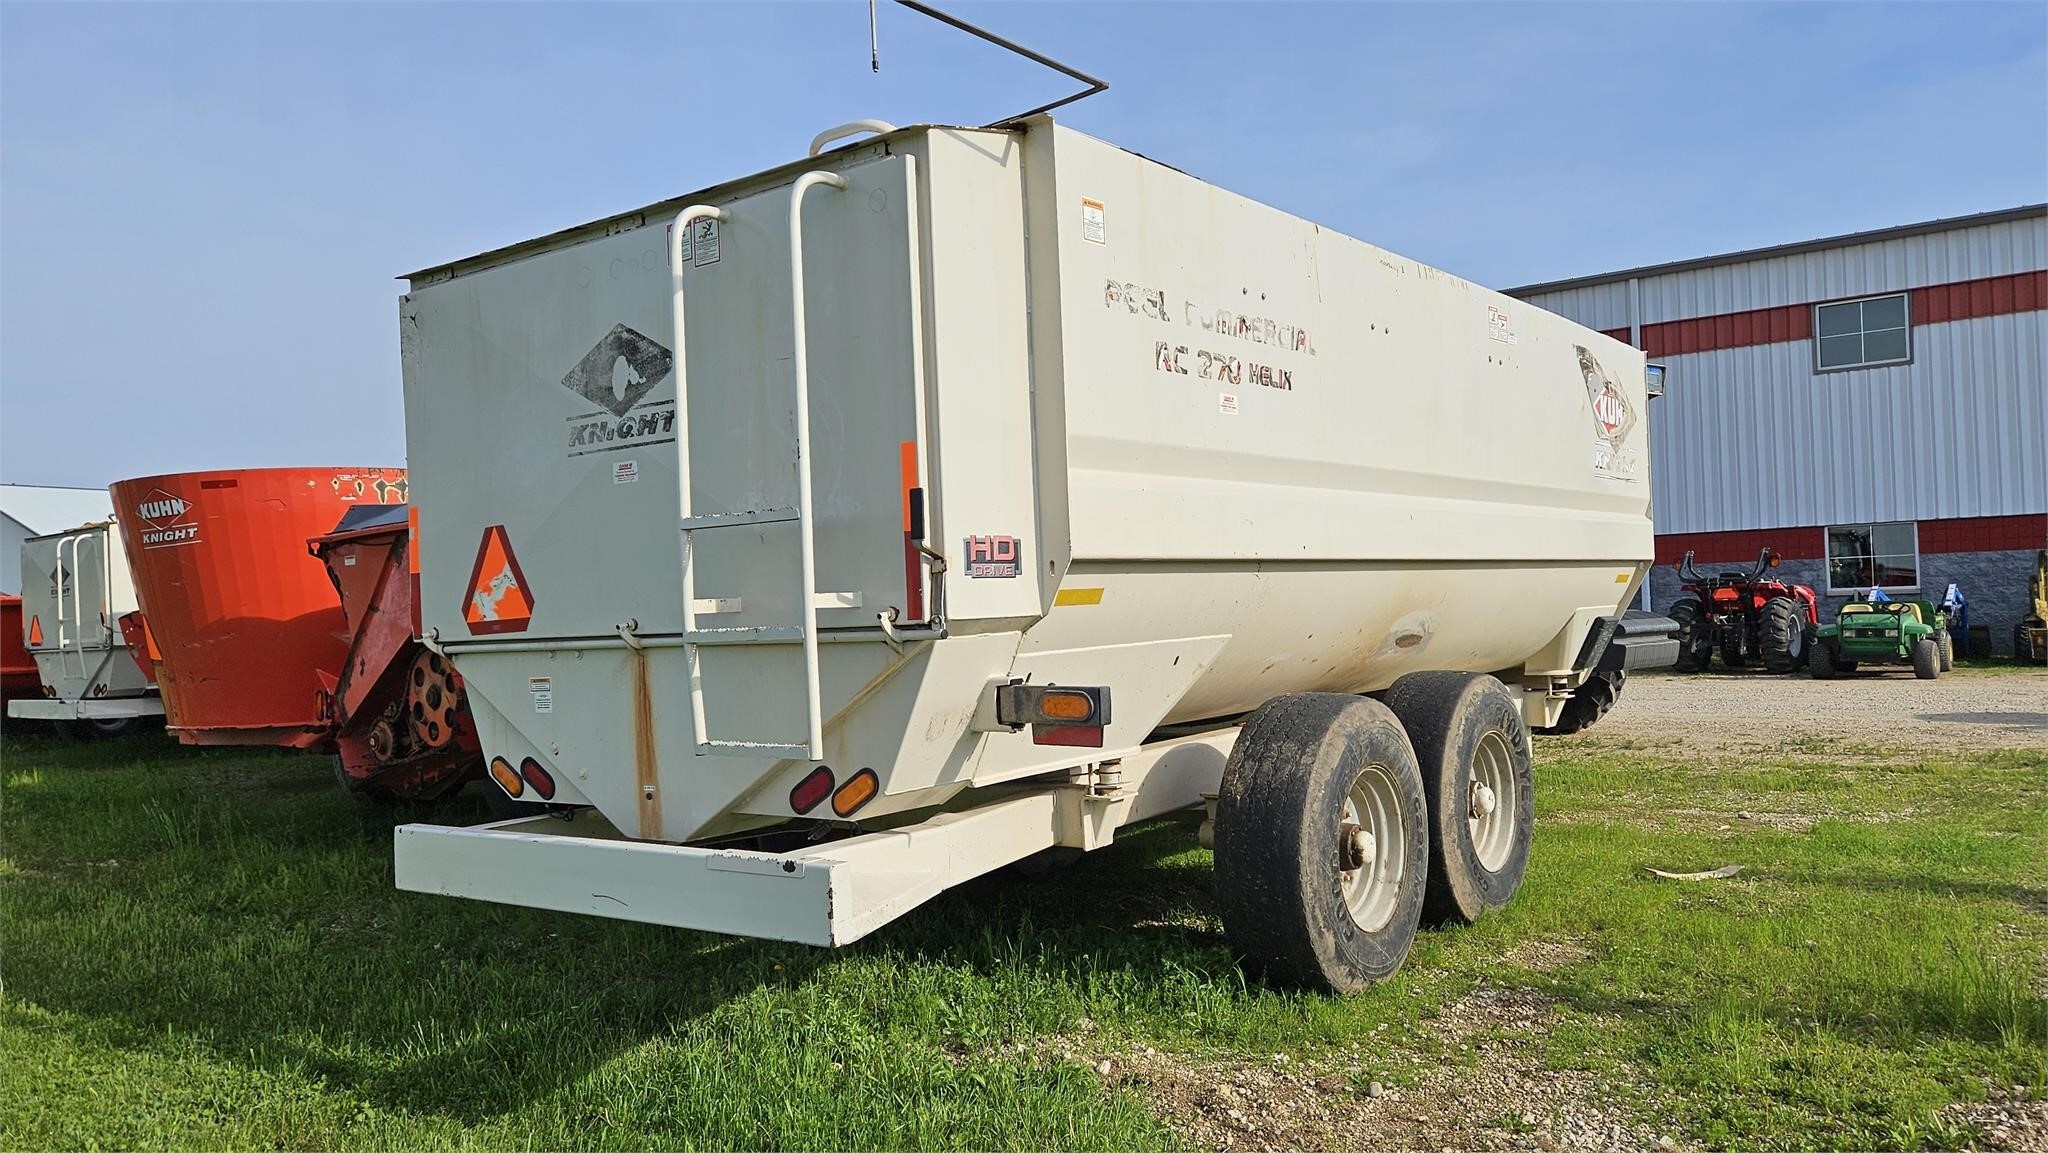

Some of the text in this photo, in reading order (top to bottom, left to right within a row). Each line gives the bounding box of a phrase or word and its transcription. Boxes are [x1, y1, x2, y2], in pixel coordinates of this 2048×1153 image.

[1197, 349, 1242, 385] 270
[1249, 362, 1292, 391] HELIX
[140, 499, 184, 519] KUHN
[143, 528, 198, 544] KNIGHT
[969, 534, 1016, 562] HD
[975, 565, 1014, 577] DRIVE
